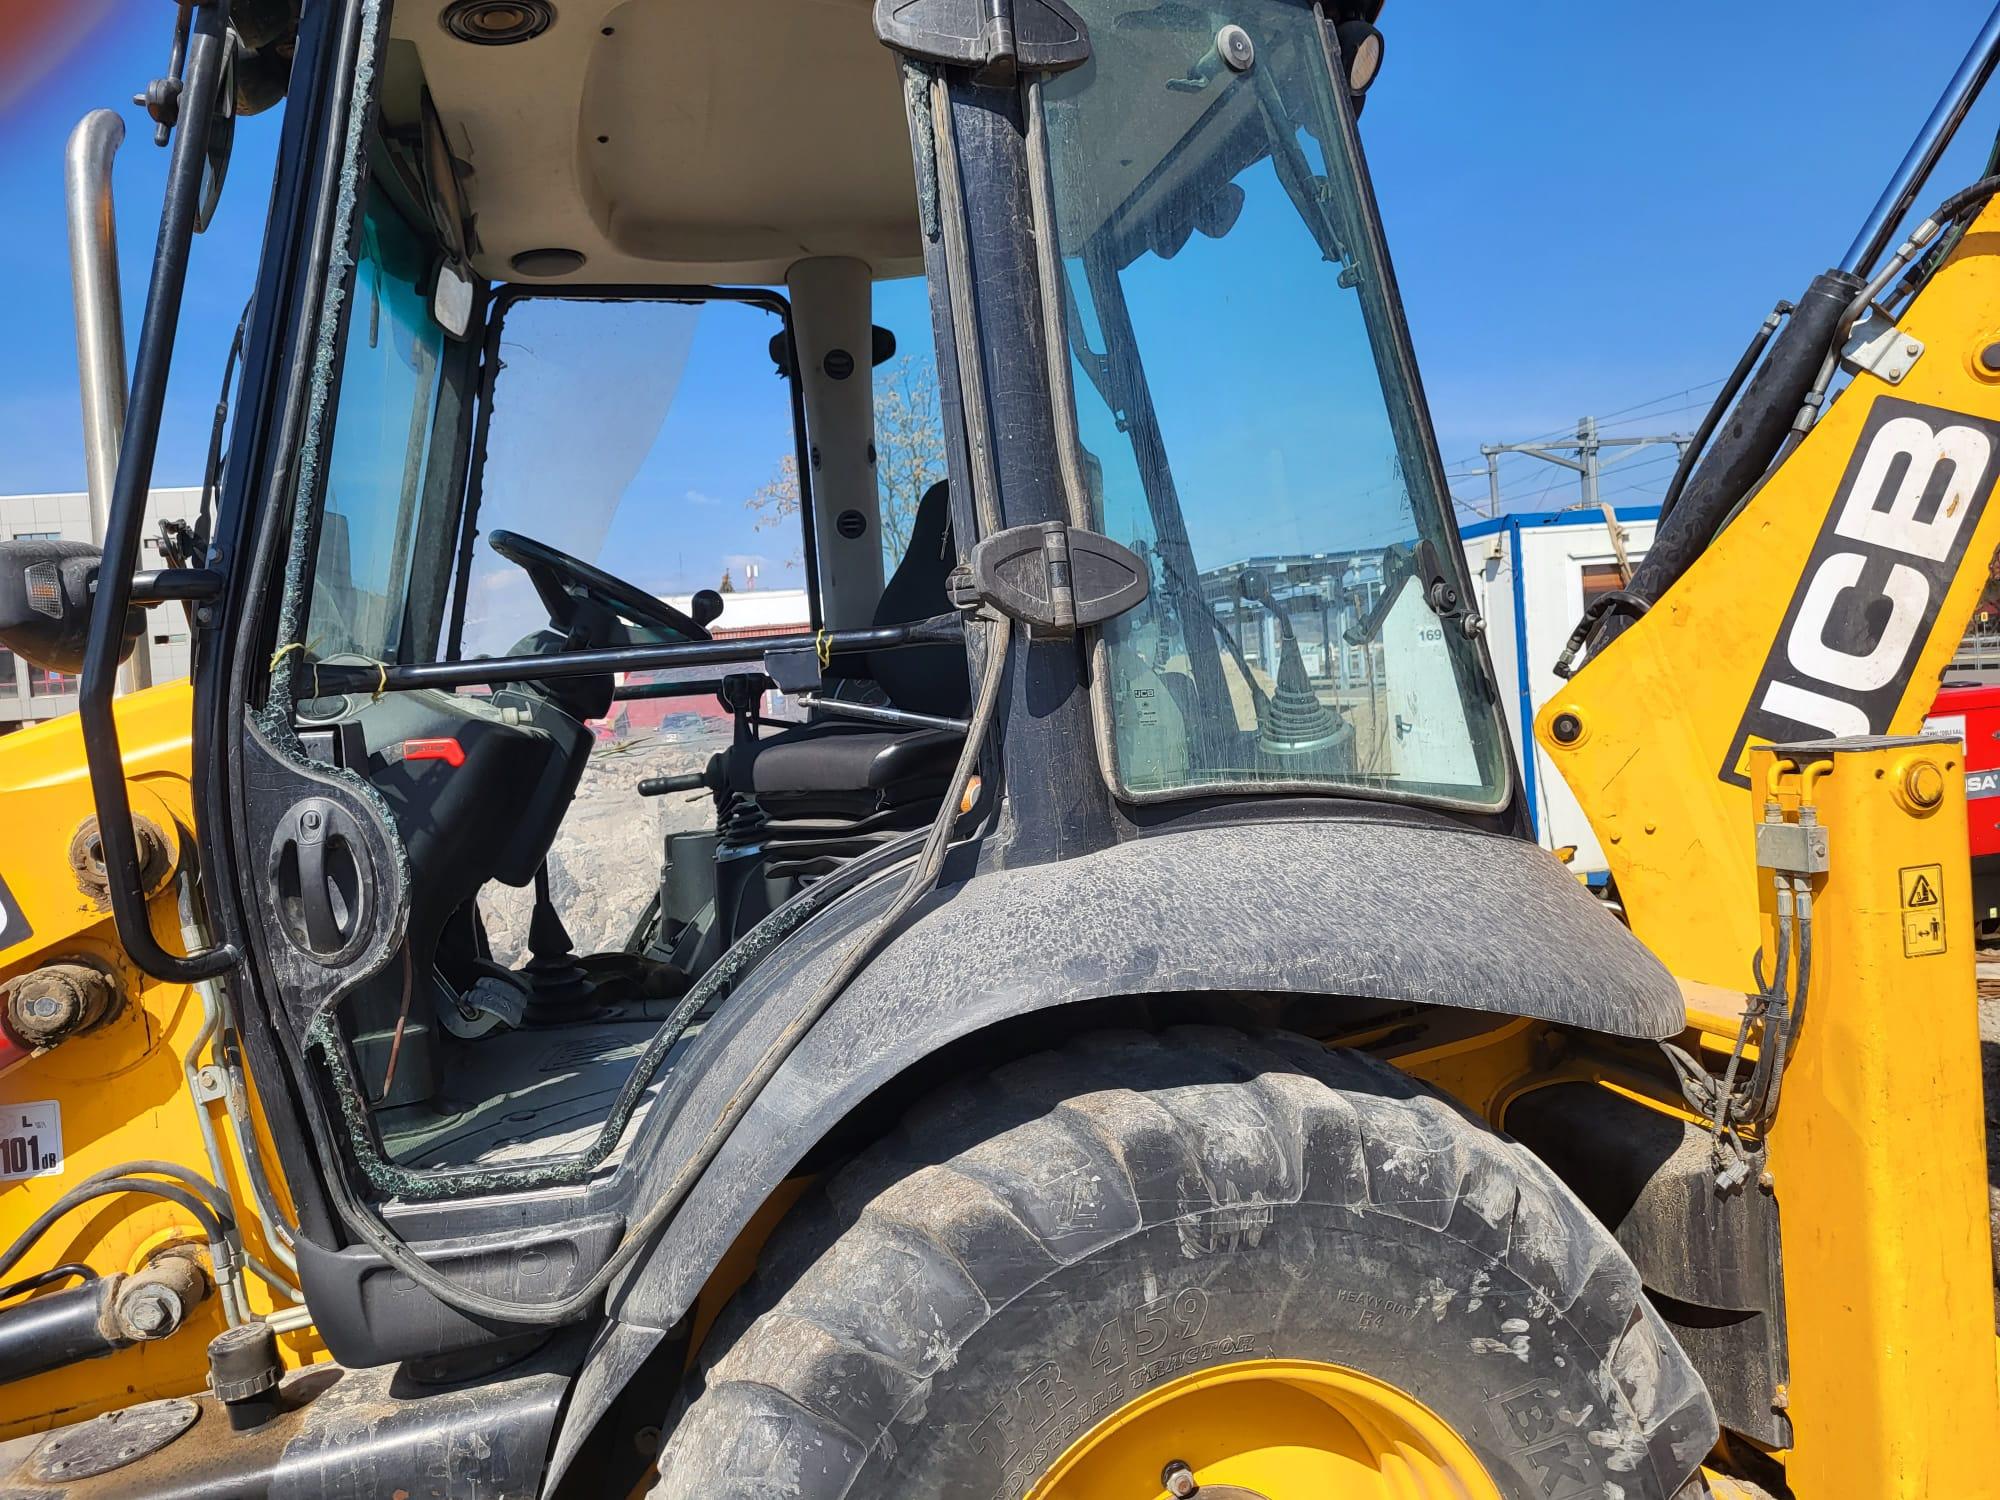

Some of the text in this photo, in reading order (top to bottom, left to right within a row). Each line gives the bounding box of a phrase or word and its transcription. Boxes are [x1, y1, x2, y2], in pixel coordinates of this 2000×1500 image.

[1760, 417, 1991, 738] JCB
[1419, 629, 1442, 641] 169
[1134, 689, 1154, 698] JCB
[1966, 775, 1996, 792] SA
[0, 1135, 40, 1174] 101
[1337, 1288, 1382, 1308] HEAVY
[1128, 1335, 1256, 1389] TRACTOR
[968, 1287, 1209, 1469] TR 459
